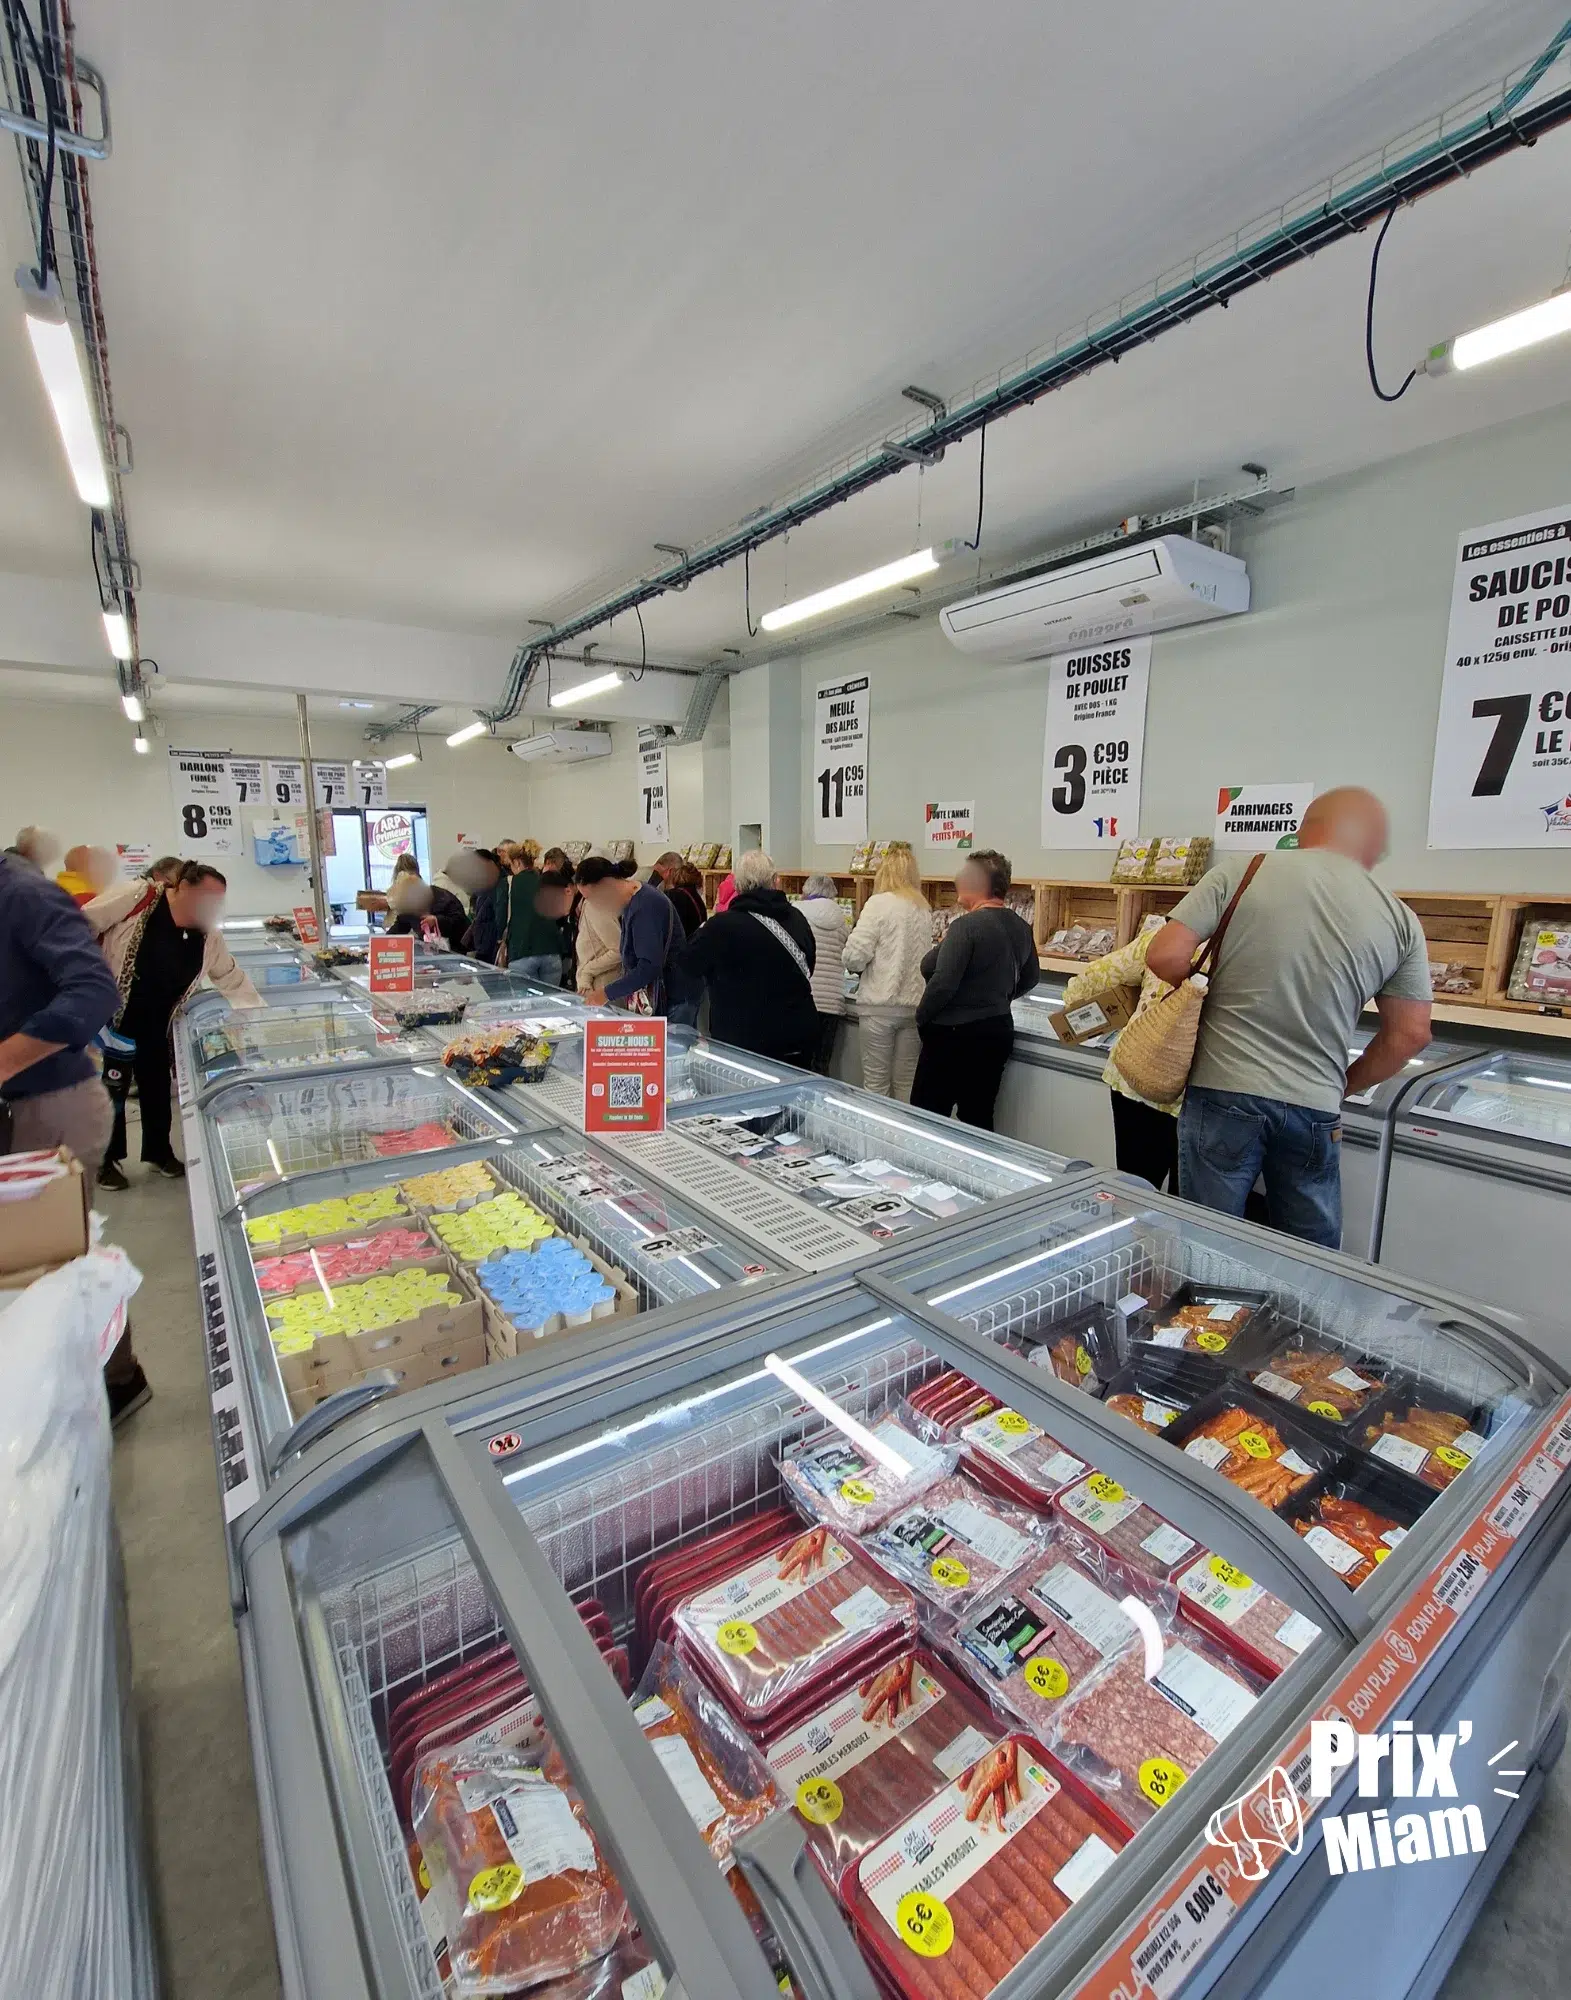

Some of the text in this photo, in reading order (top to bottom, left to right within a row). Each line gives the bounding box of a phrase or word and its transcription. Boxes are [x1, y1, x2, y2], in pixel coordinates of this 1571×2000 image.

[1467, 524, 1566, 558] Les essentiels à
[1044, 615, 1073, 626] HITACHI
[1498, 595, 1571, 628] DE PO
[1494, 627, 1557, 648] CAISSETTE
[1066, 648, 1131, 678] CUISSES
[1456, 656, 1472, 668] 40
[1473, 657, 1481, 665] x
[1482, 651, 1510, 665] 125g
[1512, 646, 1537, 661] env.
[1066, 675, 1129, 700] DE POULET
[830, 700, 855, 718] MEULE
[1073, 709, 1116, 721] Origine France
[1074, 702, 1088, 712] AVEC
[1089, 700, 1100, 709] DOS
[1109, 698, 1117, 706] KG
[826, 718, 859, 734] DES ALPES
[1471, 693, 1532, 797] 7
[1535, 729, 1564, 754] LE
[1532, 759, 1549, 768] soit
[190, 774, 217, 783] FUMÉS
[1052, 740, 1129, 815] 3 €99
[1092, 766, 1129, 785] PIÈCE
[236, 782, 247, 803] 7
[276, 783, 291, 804] 9
[322, 784, 333, 805] 7
[361, 786, 372, 805] 7
[818, 765, 864, 818] 11 €95
[846, 784, 864, 797] LE KG
[643, 787, 652, 824] 7
[930, 807, 970, 819] TOUTE L'ANNÉE
[1230, 802, 1293, 816] ARRIVAGES
[182, 804, 231, 838] 8 €95
[210, 817, 233, 827] PIÈCE
[381, 815, 401, 832] ARP
[1224, 819, 1297, 832] PERMANENTS
[375, 827, 411, 845] Primeurs
[932, 830, 966, 842] PETITS PRIX
[597, 1035, 649, 1047] SUIVEZ-NOUS
[997, 1415, 1025, 1426] 2,5€
[1090, 1475, 1115, 1495] 2,5€
[1473, 1529, 1499, 1560] PLAN
[1216, 1560, 1234, 1583] 2,5
[1456, 1558, 1477, 1580] 2,50
[753, 1587, 783, 1609] MERGUEZ
[1406, 1592, 1445, 1643] BON PLA
[724, 1627, 747, 1640] 6€
[1033, 1665, 1050, 1687] 8€
[1347, 1654, 1400, 1720] BON PLAN
[795, 1731, 871, 1786] VÉRITABLES MERGUEZ
[1150, 1769, 1169, 1795] 8€
[804, 1785, 831, 1806] 6€
[941, 1835, 978, 1873] MERGUEZ
[1185, 1884, 1216, 1924] 6,00
[1206, 1875, 1223, 1896] €
[907, 1902, 933, 1935] 6€
[1136, 1933, 1162, 1971] MERGUEZ
